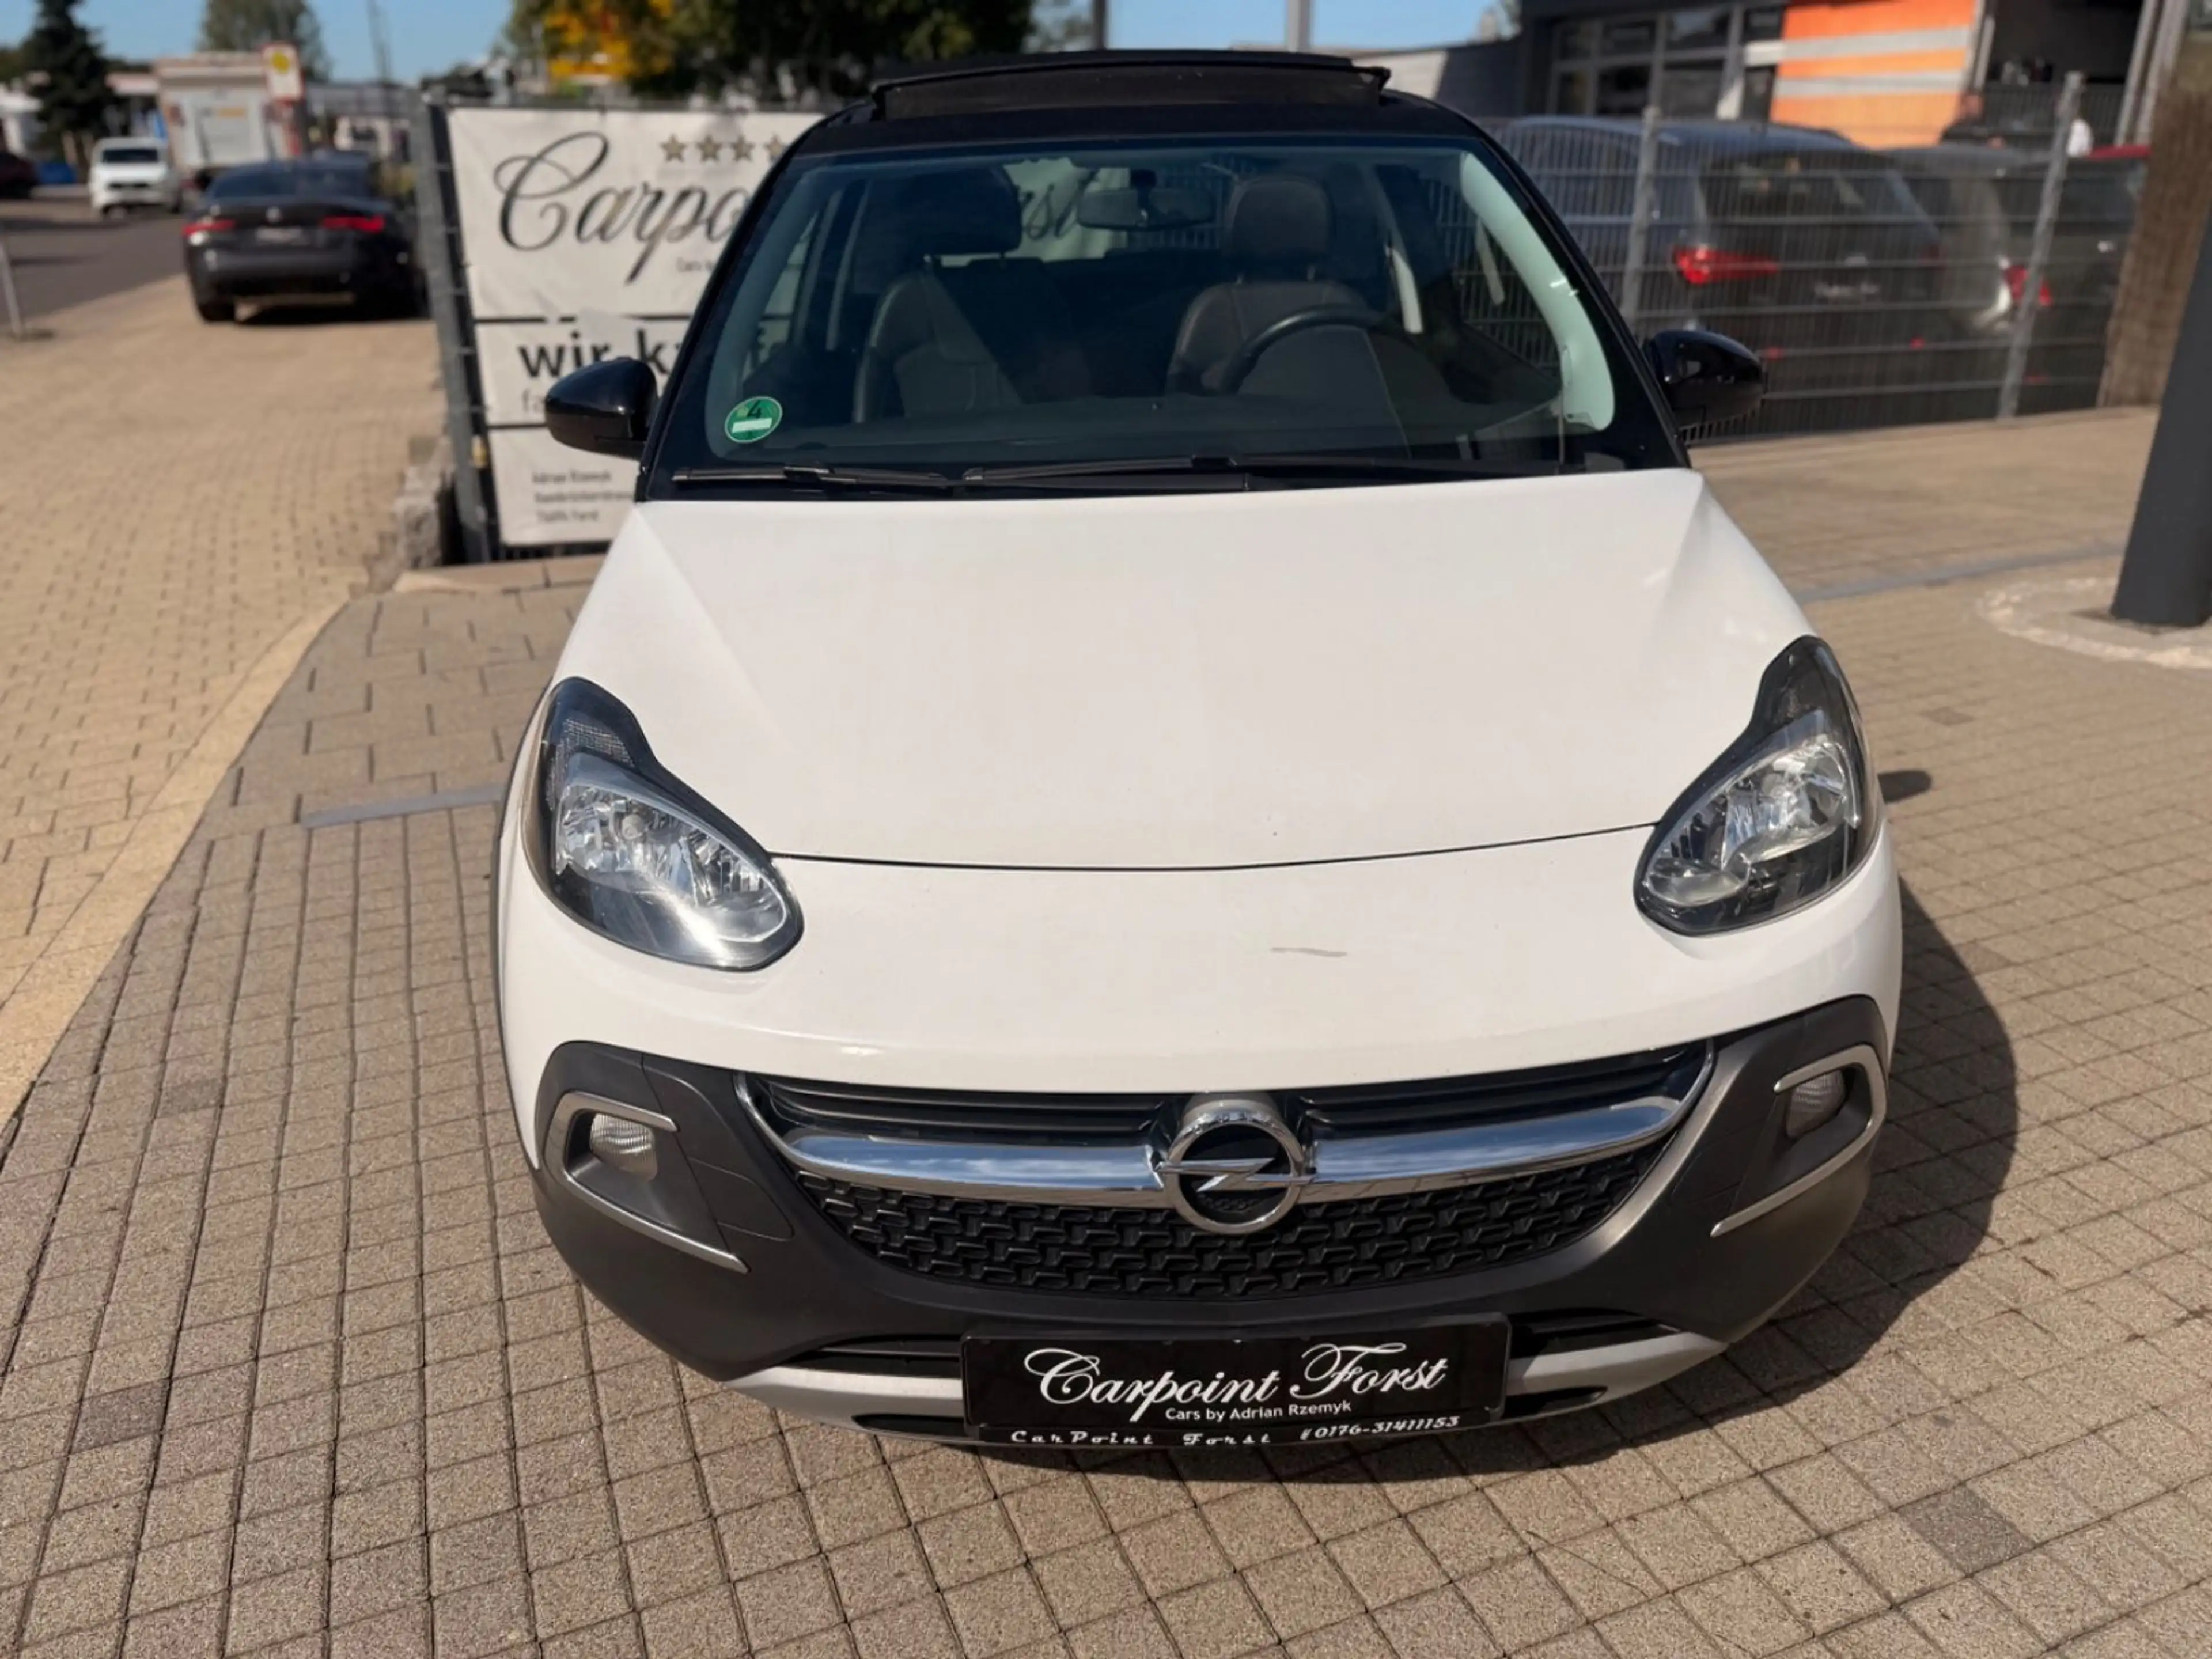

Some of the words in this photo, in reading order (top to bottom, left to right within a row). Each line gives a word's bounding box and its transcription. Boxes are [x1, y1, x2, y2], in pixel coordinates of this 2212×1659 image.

[747, 400, 762, 419] 4
[1024, 1347, 1279, 1422] Carpoint
[1289, 1342, 1449, 1399] Forst
[1165, 1407, 1201, 1421] Cars
[1206, 1407, 1226, 1423] by
[1229, 1406, 1283, 1420] Adrian
[1288, 1400, 1352, 1416] Rzemyk
